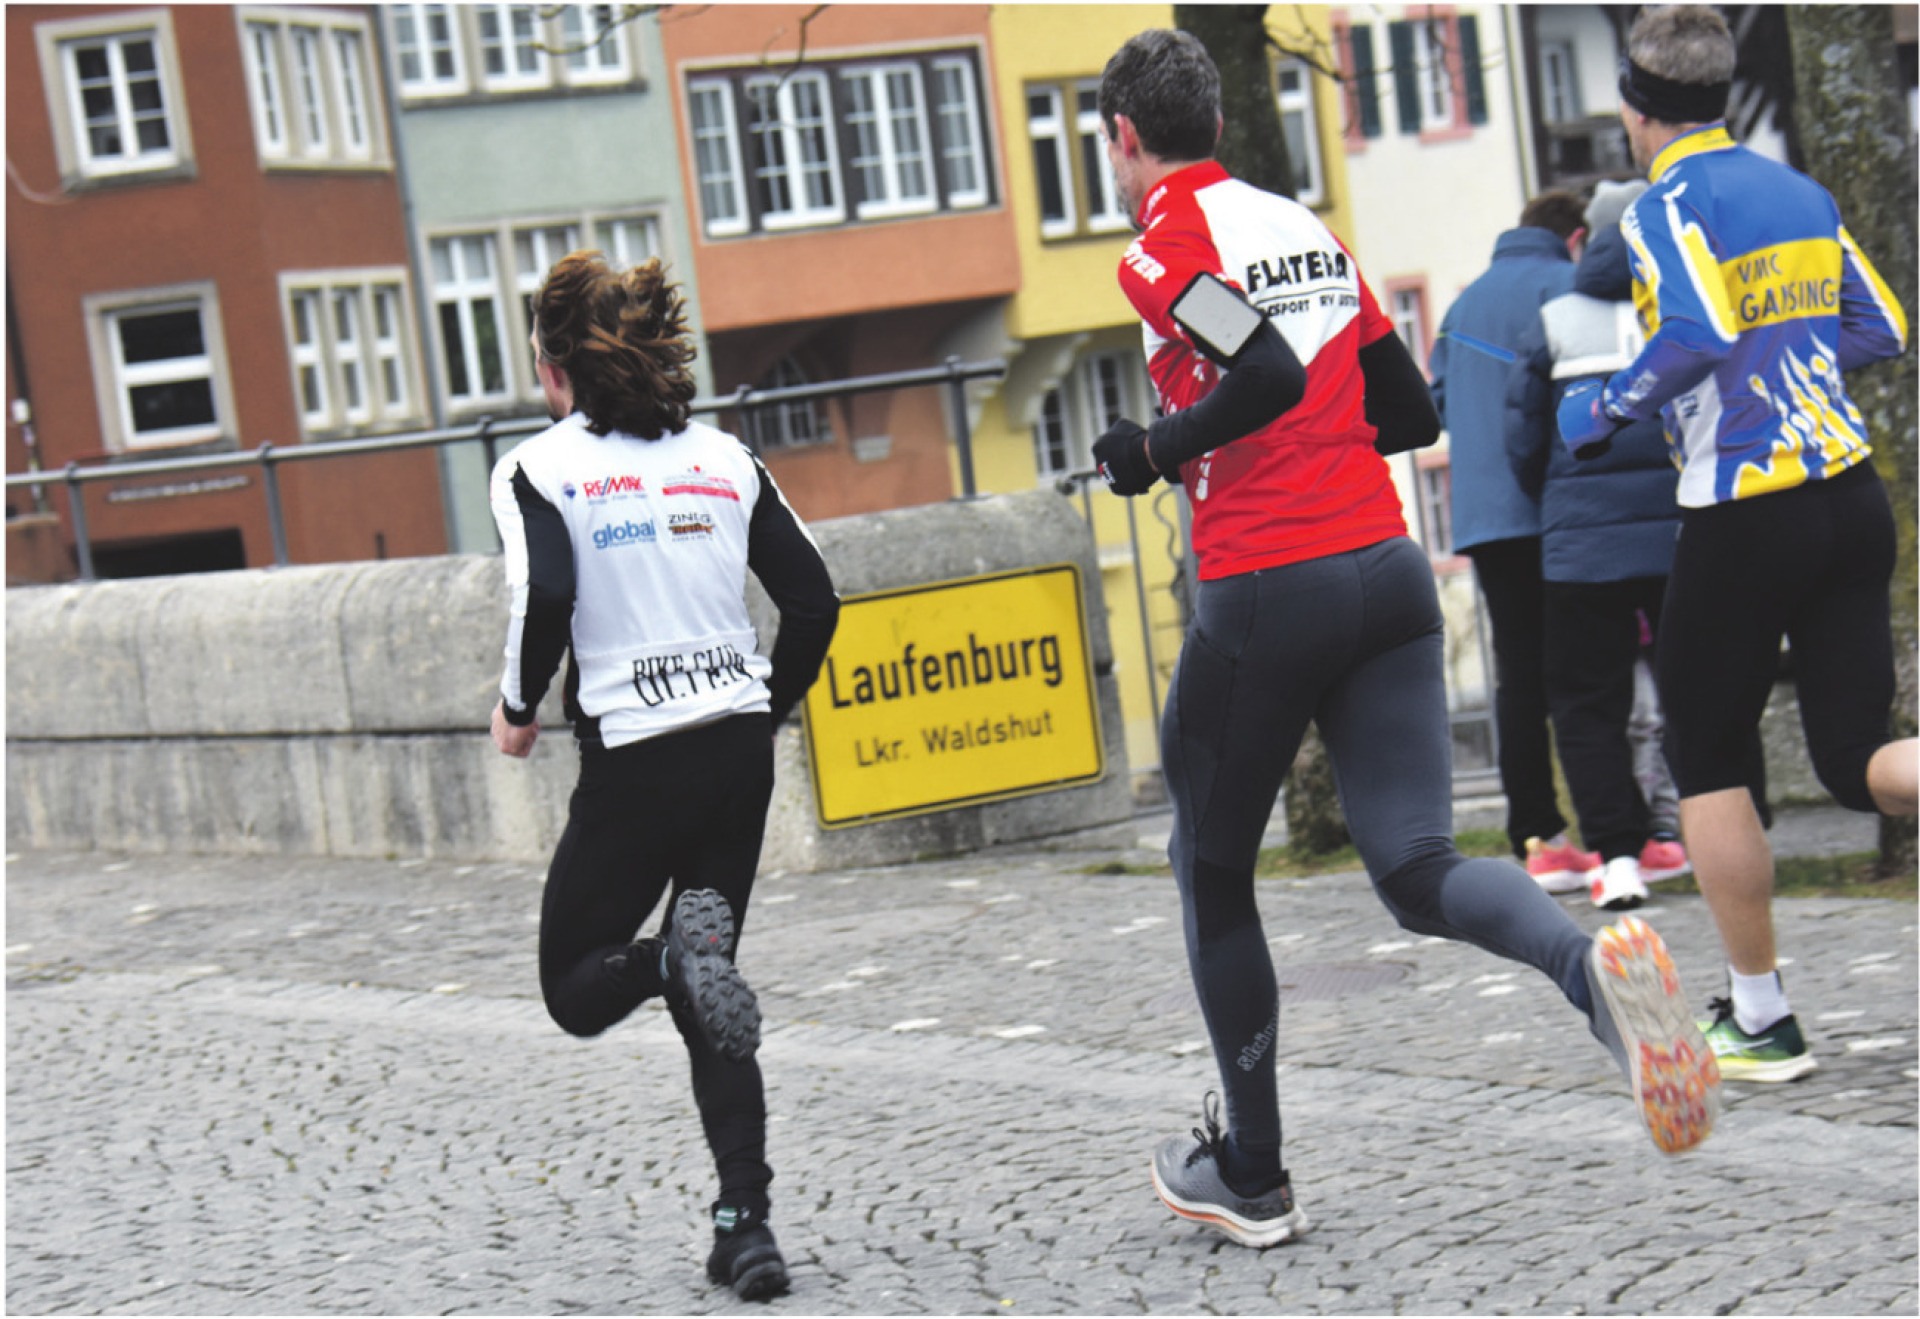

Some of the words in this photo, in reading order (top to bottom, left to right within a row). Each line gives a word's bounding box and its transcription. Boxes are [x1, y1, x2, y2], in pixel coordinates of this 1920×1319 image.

[1737, 253, 1783, 284] VMC
[593, 519, 657, 551] global
[827, 632, 1063, 709] Laufenburg
[856, 736, 911, 768] Lkr.
[921, 709, 1054, 755] Waldshut
